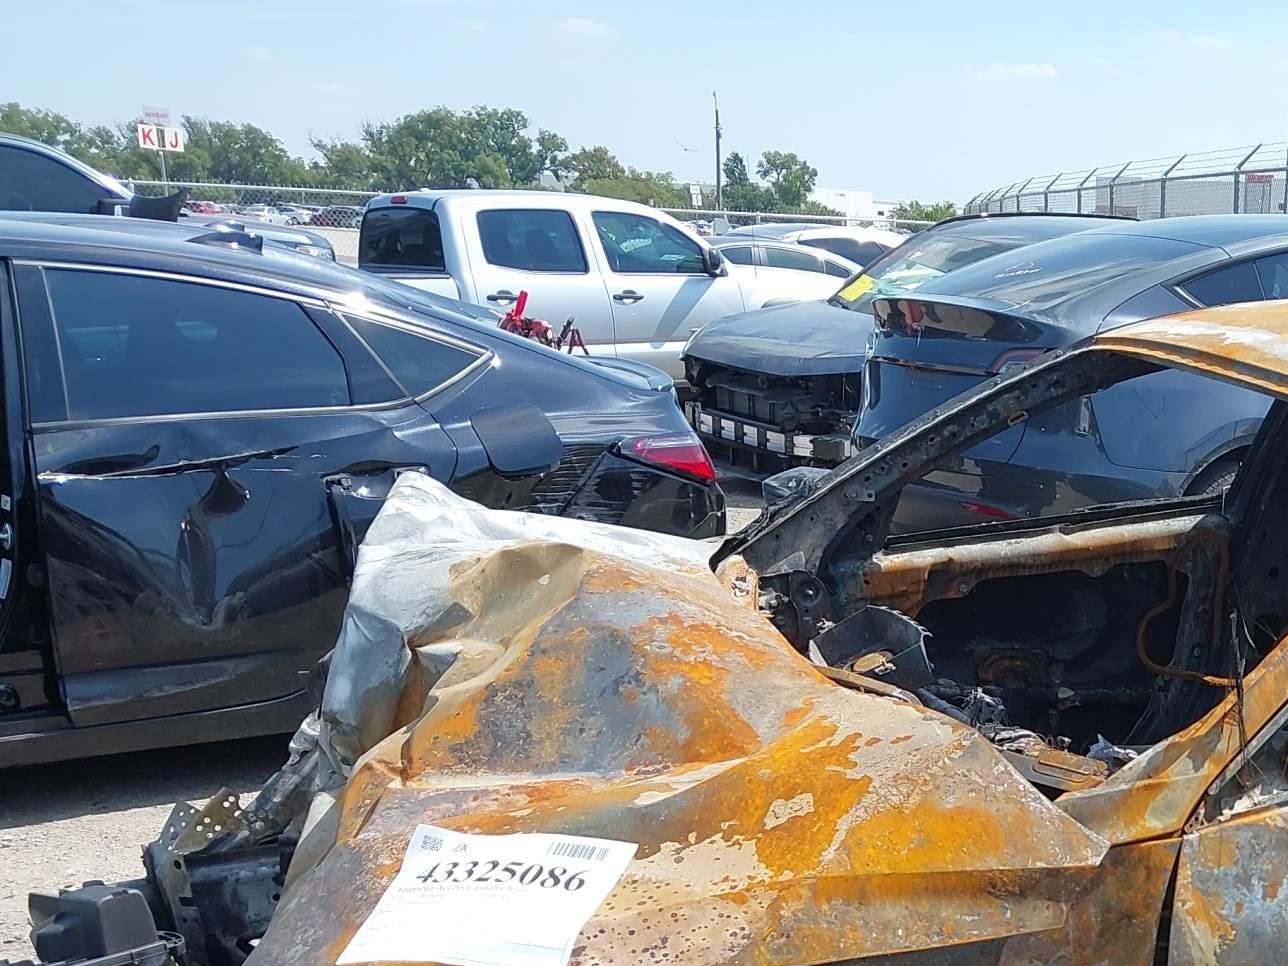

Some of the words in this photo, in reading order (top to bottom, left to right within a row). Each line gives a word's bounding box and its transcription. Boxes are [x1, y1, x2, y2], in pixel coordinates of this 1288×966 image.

[142, 127, 155, 146] K
[170, 131, 179, 148] J
[415, 859, 591, 892] 43325086
